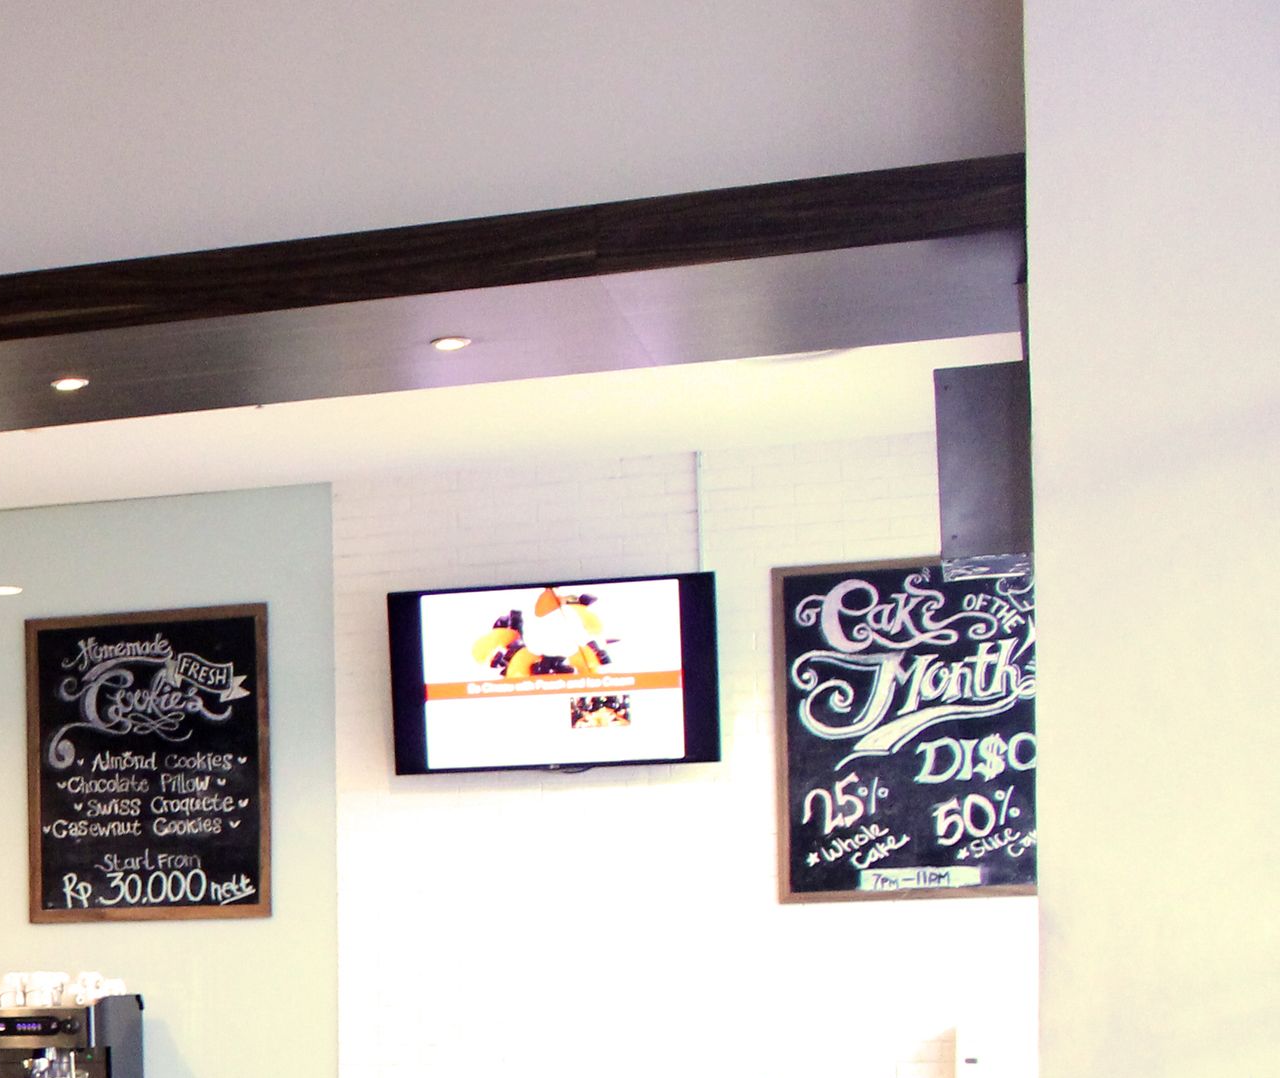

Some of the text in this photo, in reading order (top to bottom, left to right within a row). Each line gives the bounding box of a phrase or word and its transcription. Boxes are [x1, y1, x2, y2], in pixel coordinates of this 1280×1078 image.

[796, 574, 947, 652] Cake
[61, 633, 174, 671] Homemade
[180, 657, 228, 685] FRESH
[793, 637, 1022, 738] Month
[60, 667, 232, 734] Cookies
[92, 751, 234, 772] Almond Cookies
[67, 773, 212, 794] Chocolate Pillow
[802, 772, 889, 835] 25%
[932, 785, 1021, 846] 50%
[153, 817, 223, 836] Cookies
[94, 848, 155, 872] Start
[210, 873, 255, 900] nett
